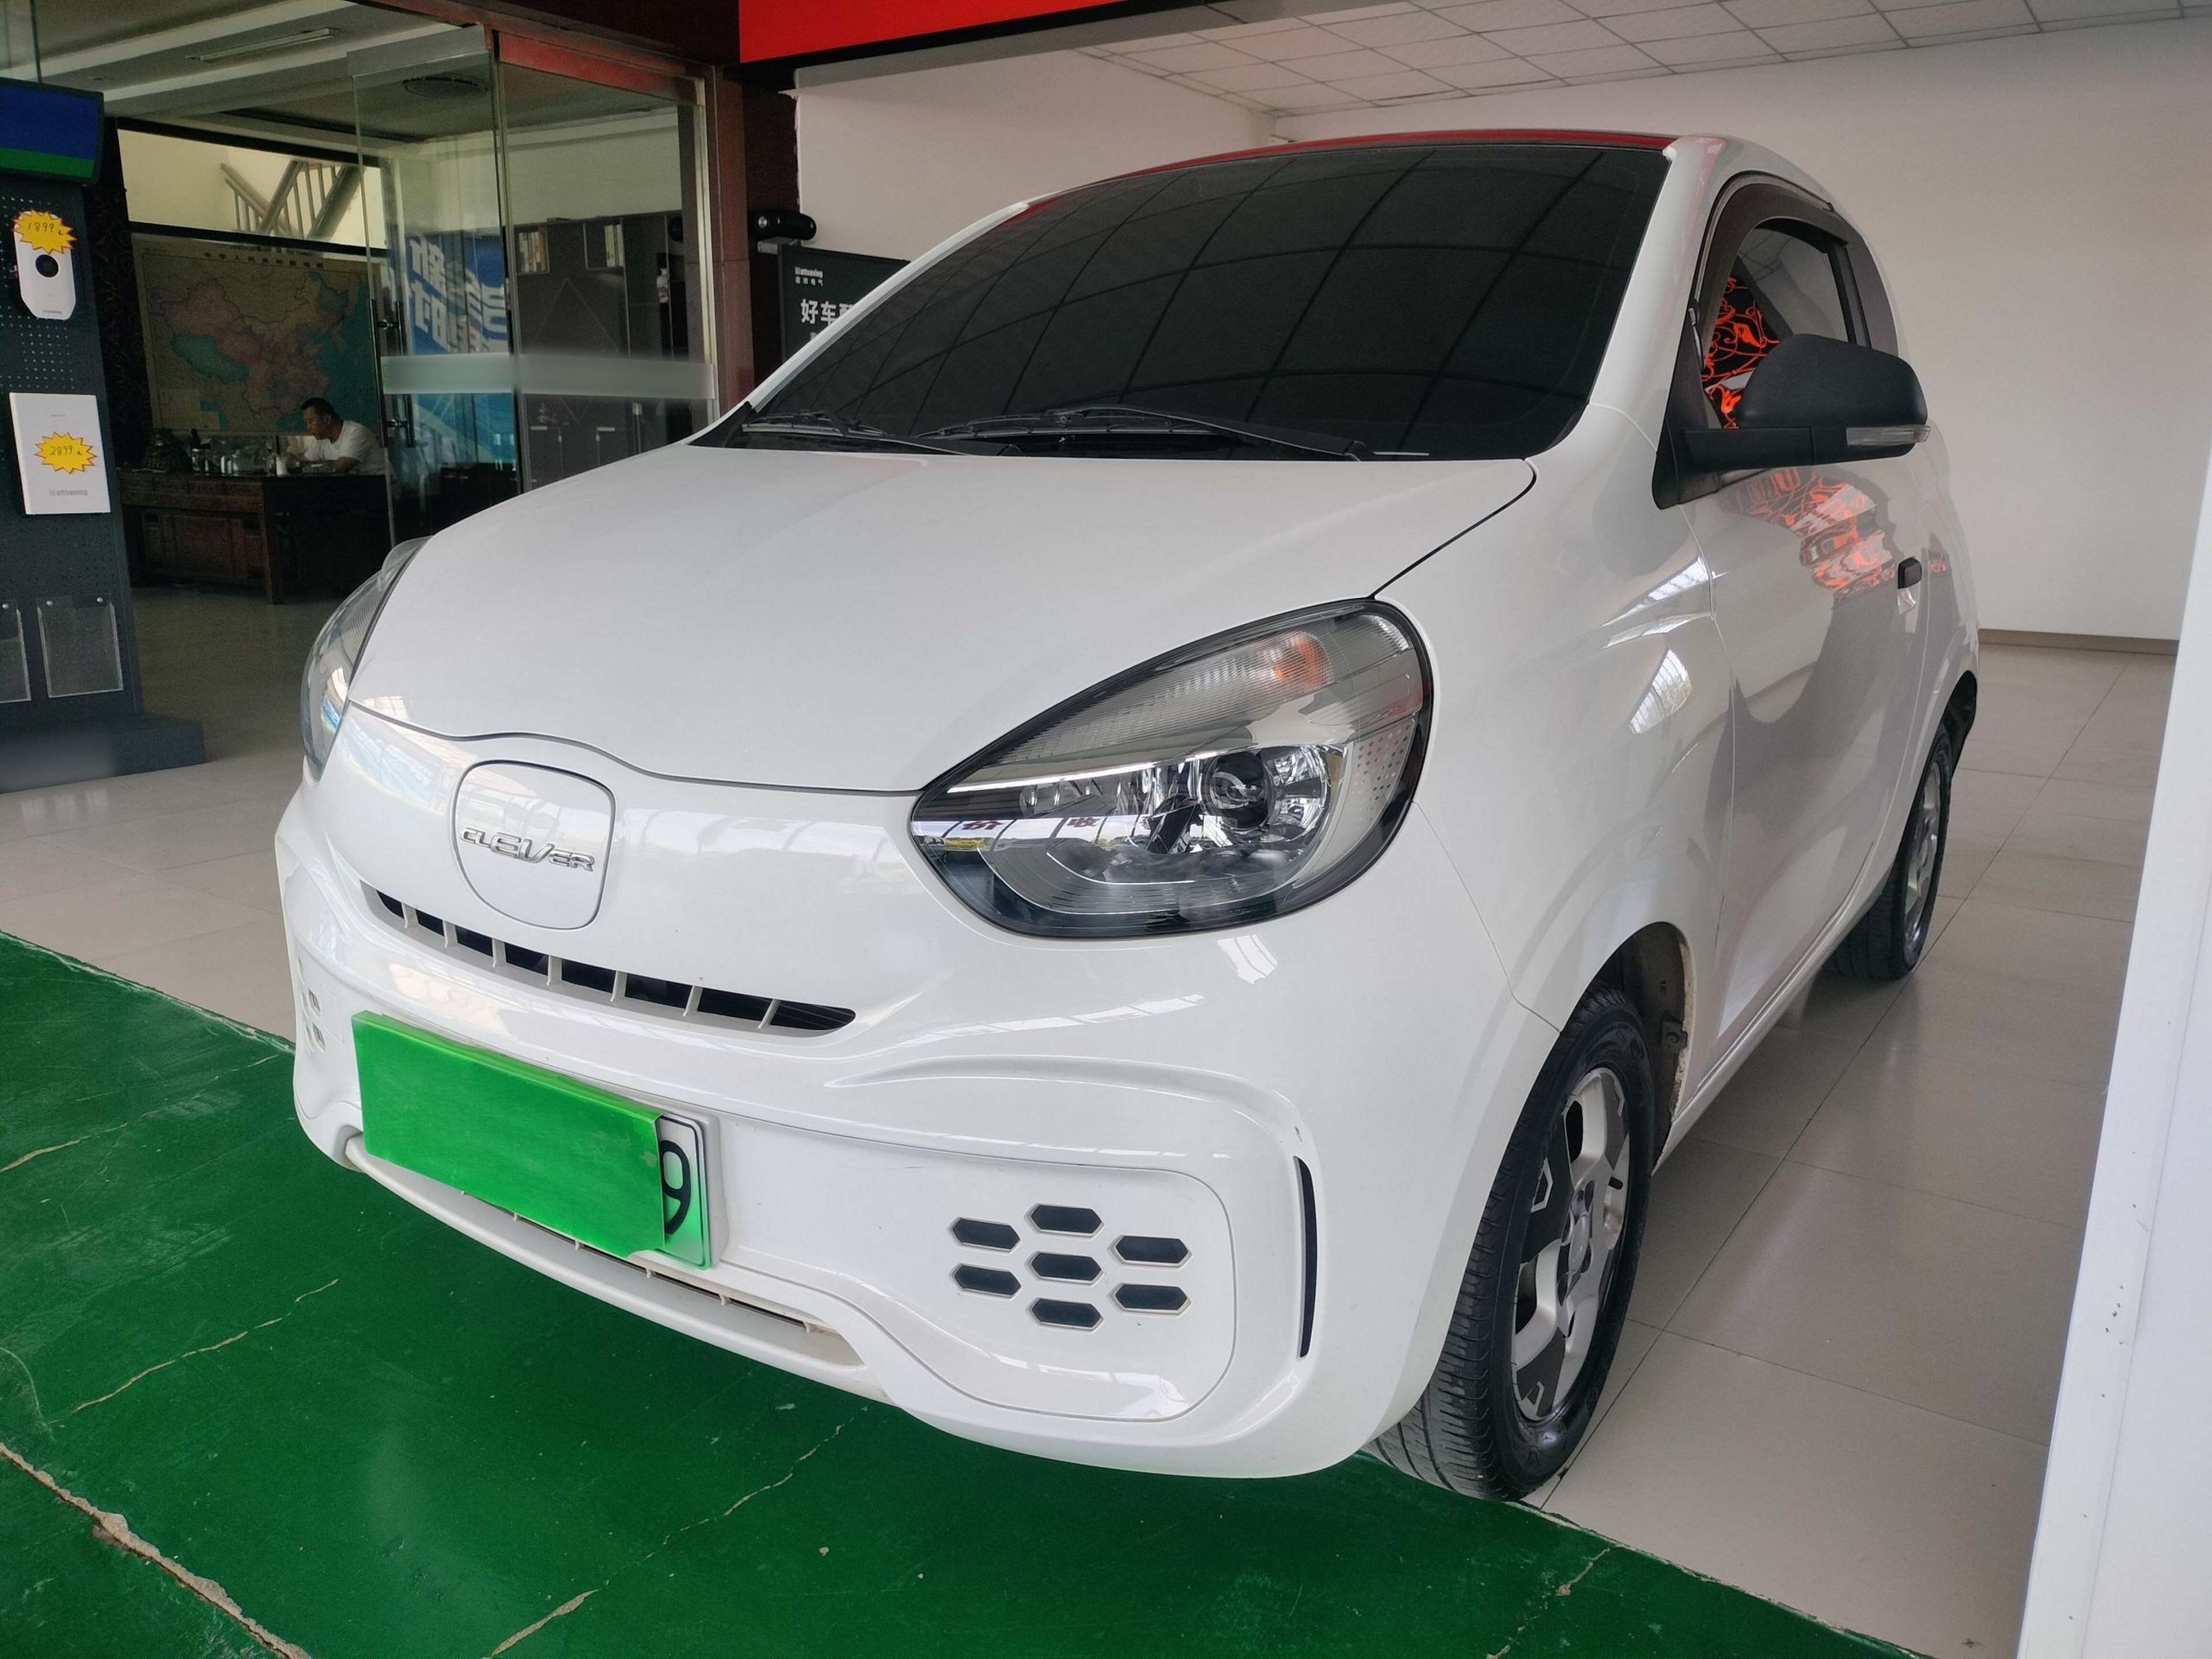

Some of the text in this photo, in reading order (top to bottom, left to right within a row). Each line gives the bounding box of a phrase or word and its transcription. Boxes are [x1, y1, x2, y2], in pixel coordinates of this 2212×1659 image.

[28, 222, 55, 233] 1899
[49, 445, 73, 456] 2899
[460, 827, 595, 872] CLEVER
